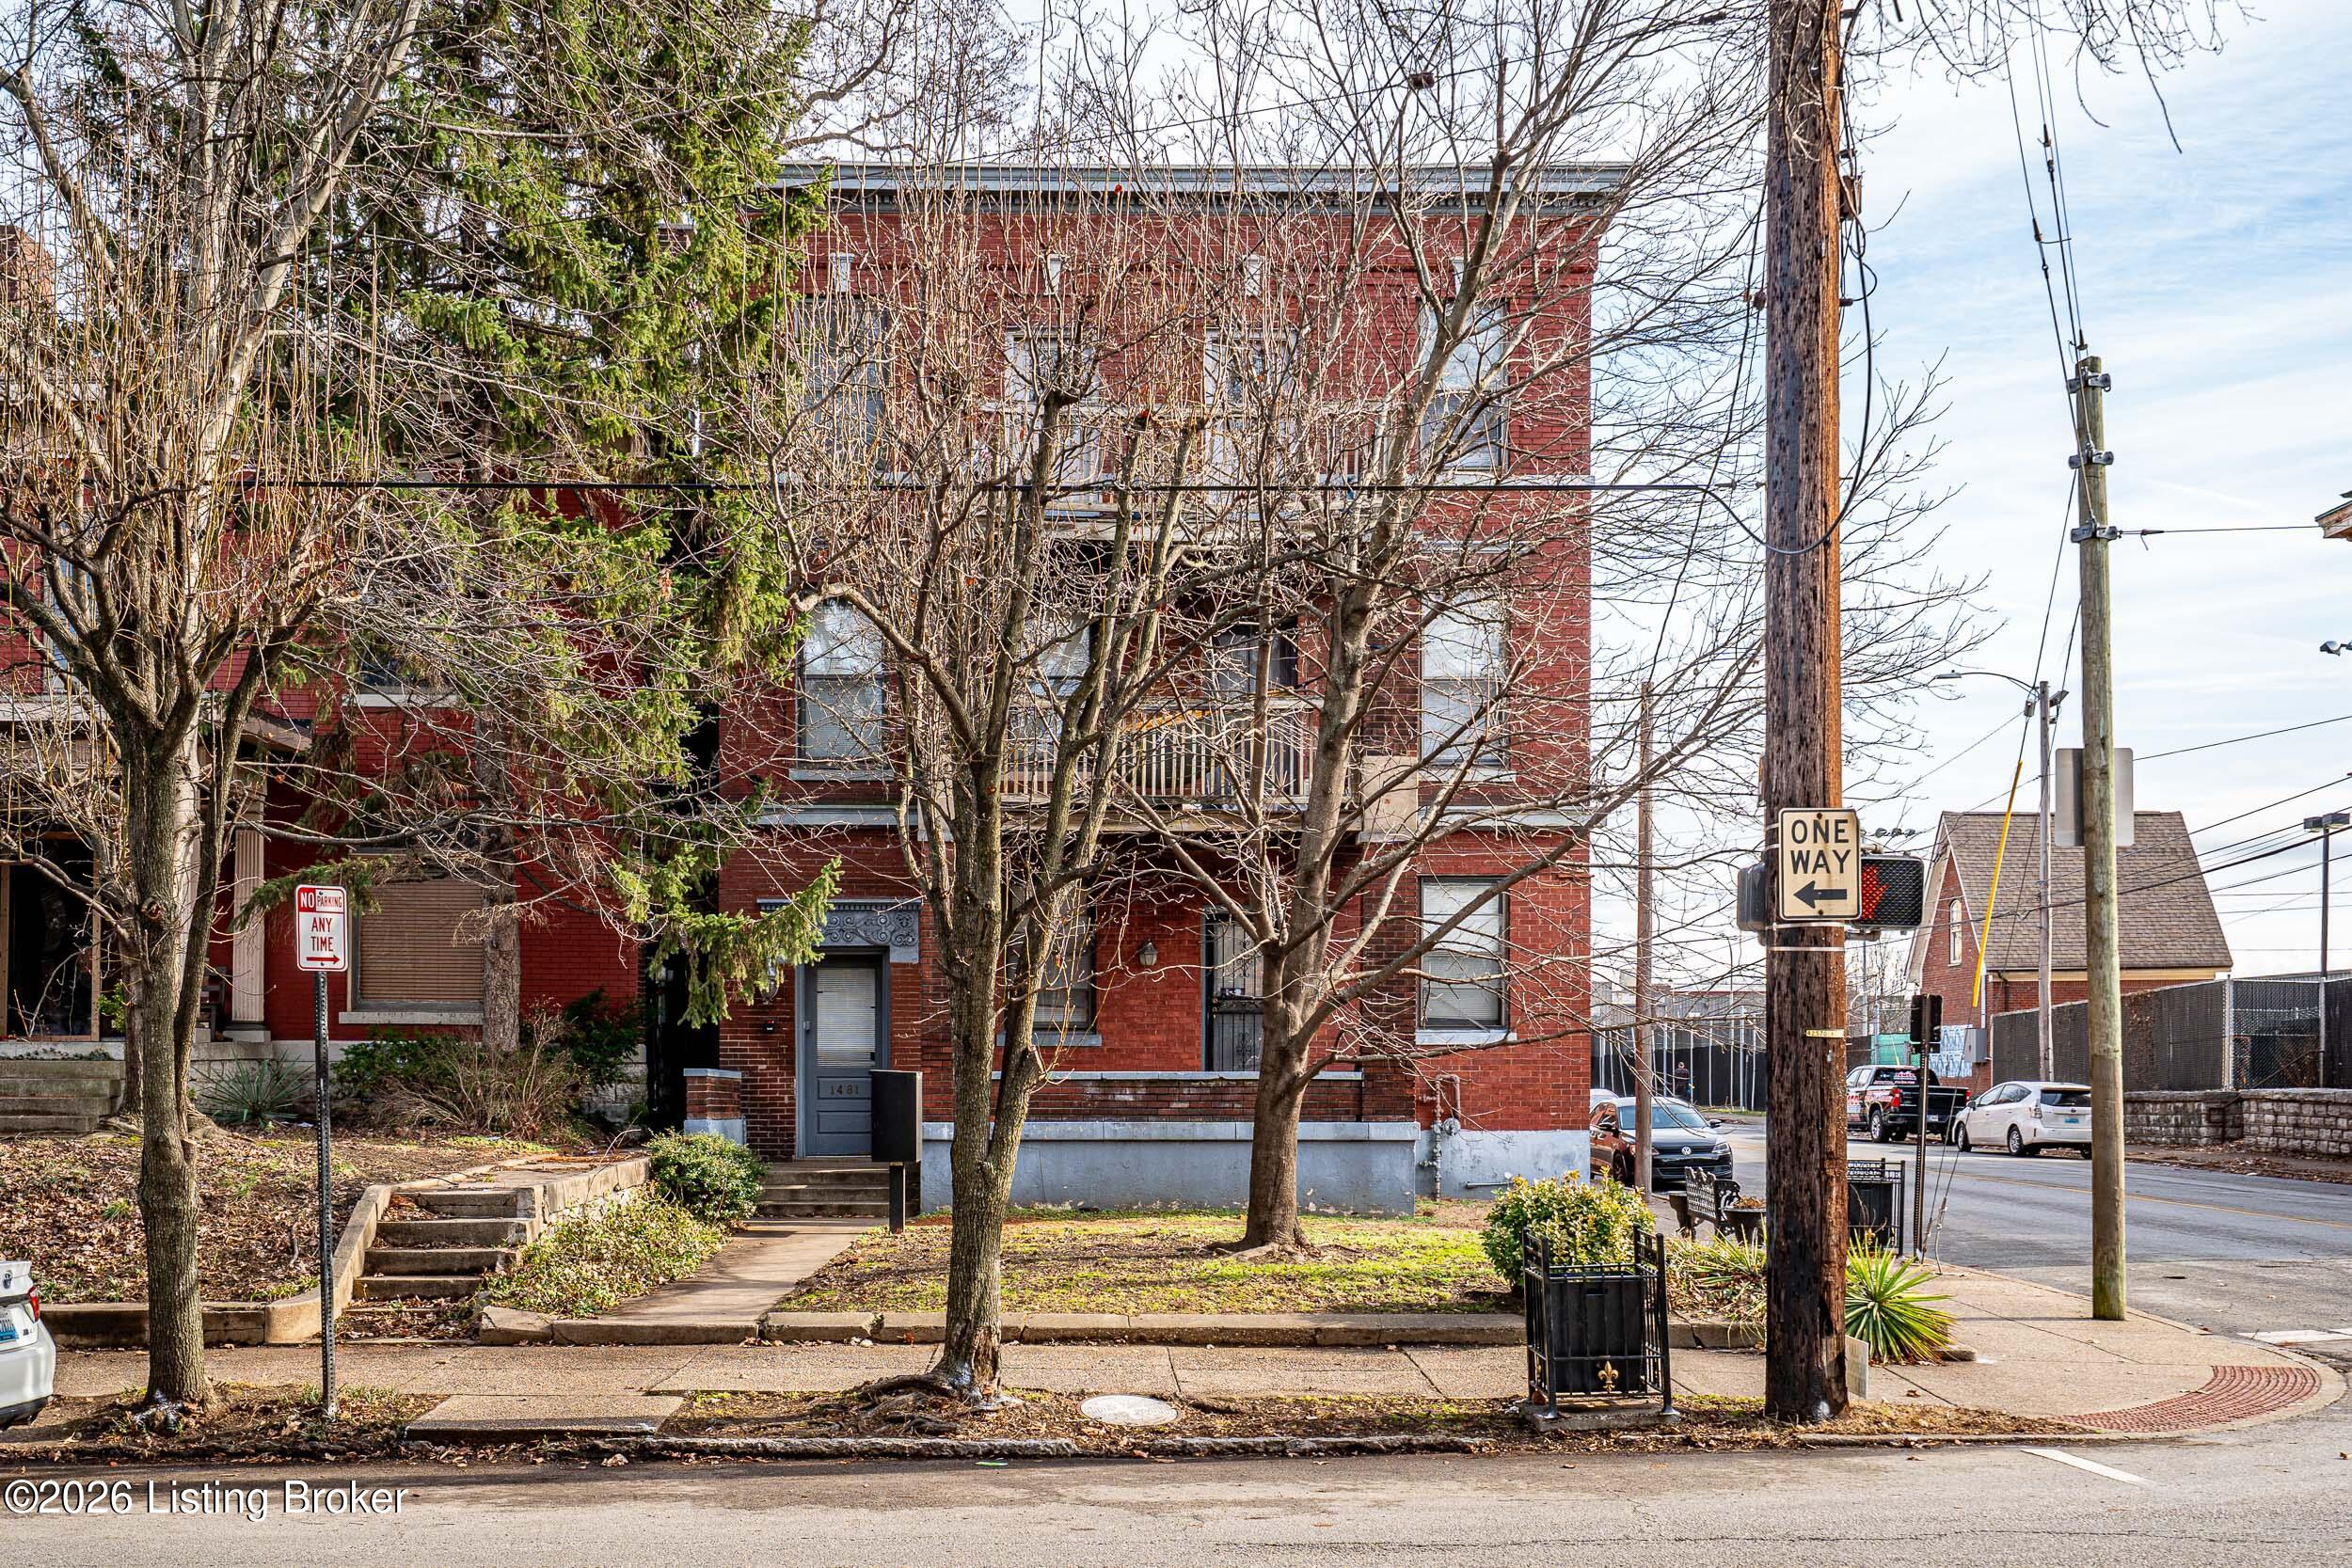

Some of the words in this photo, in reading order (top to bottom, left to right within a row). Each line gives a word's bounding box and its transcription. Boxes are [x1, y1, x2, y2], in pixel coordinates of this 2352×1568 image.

[1790, 819, 1850, 845] ONE
[1790, 849, 1851, 875] WAY
[300, 892, 315, 909] NO
[316, 895, 342, 908] PARKING
[310, 917, 333, 932] ANY
[310, 936, 334, 952] TIME
